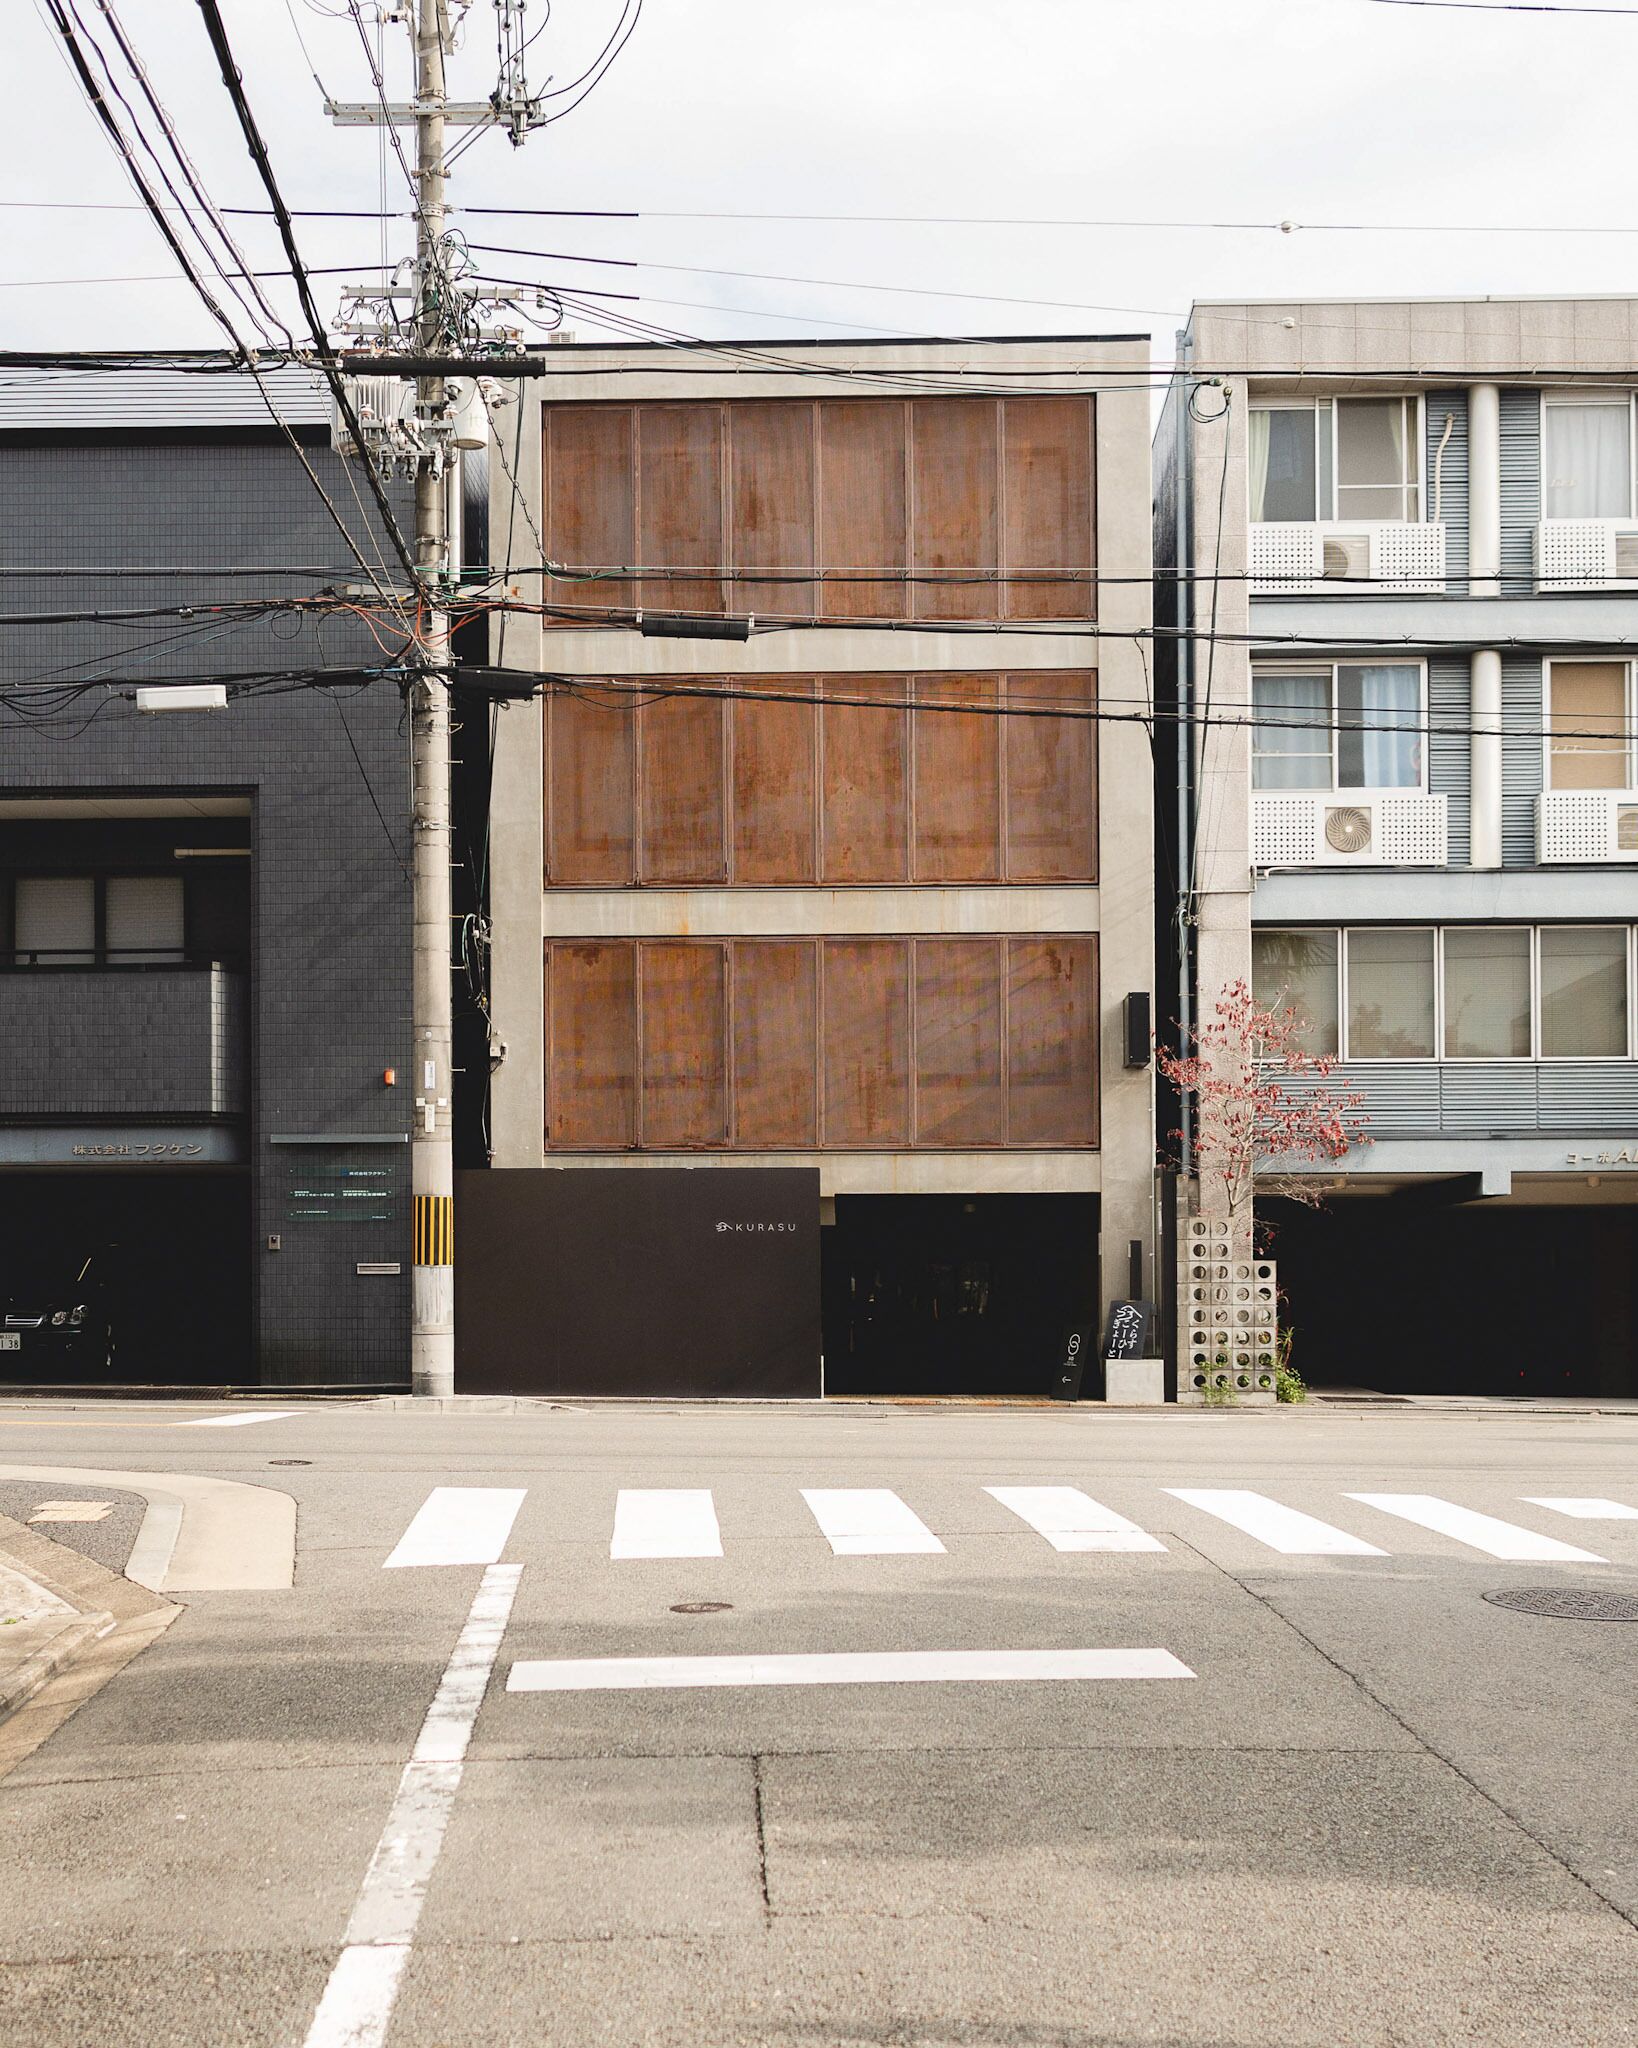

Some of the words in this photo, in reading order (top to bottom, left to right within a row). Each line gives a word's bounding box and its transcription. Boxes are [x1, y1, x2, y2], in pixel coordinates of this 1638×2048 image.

[72, 1143, 202, 1155] 株式会社フクケン
[735, 1223, 796, 1232] KURASU
[1118, 1320, 1129, 1359] こーひー
[1128, 1319, 1139, 1349] くらす
